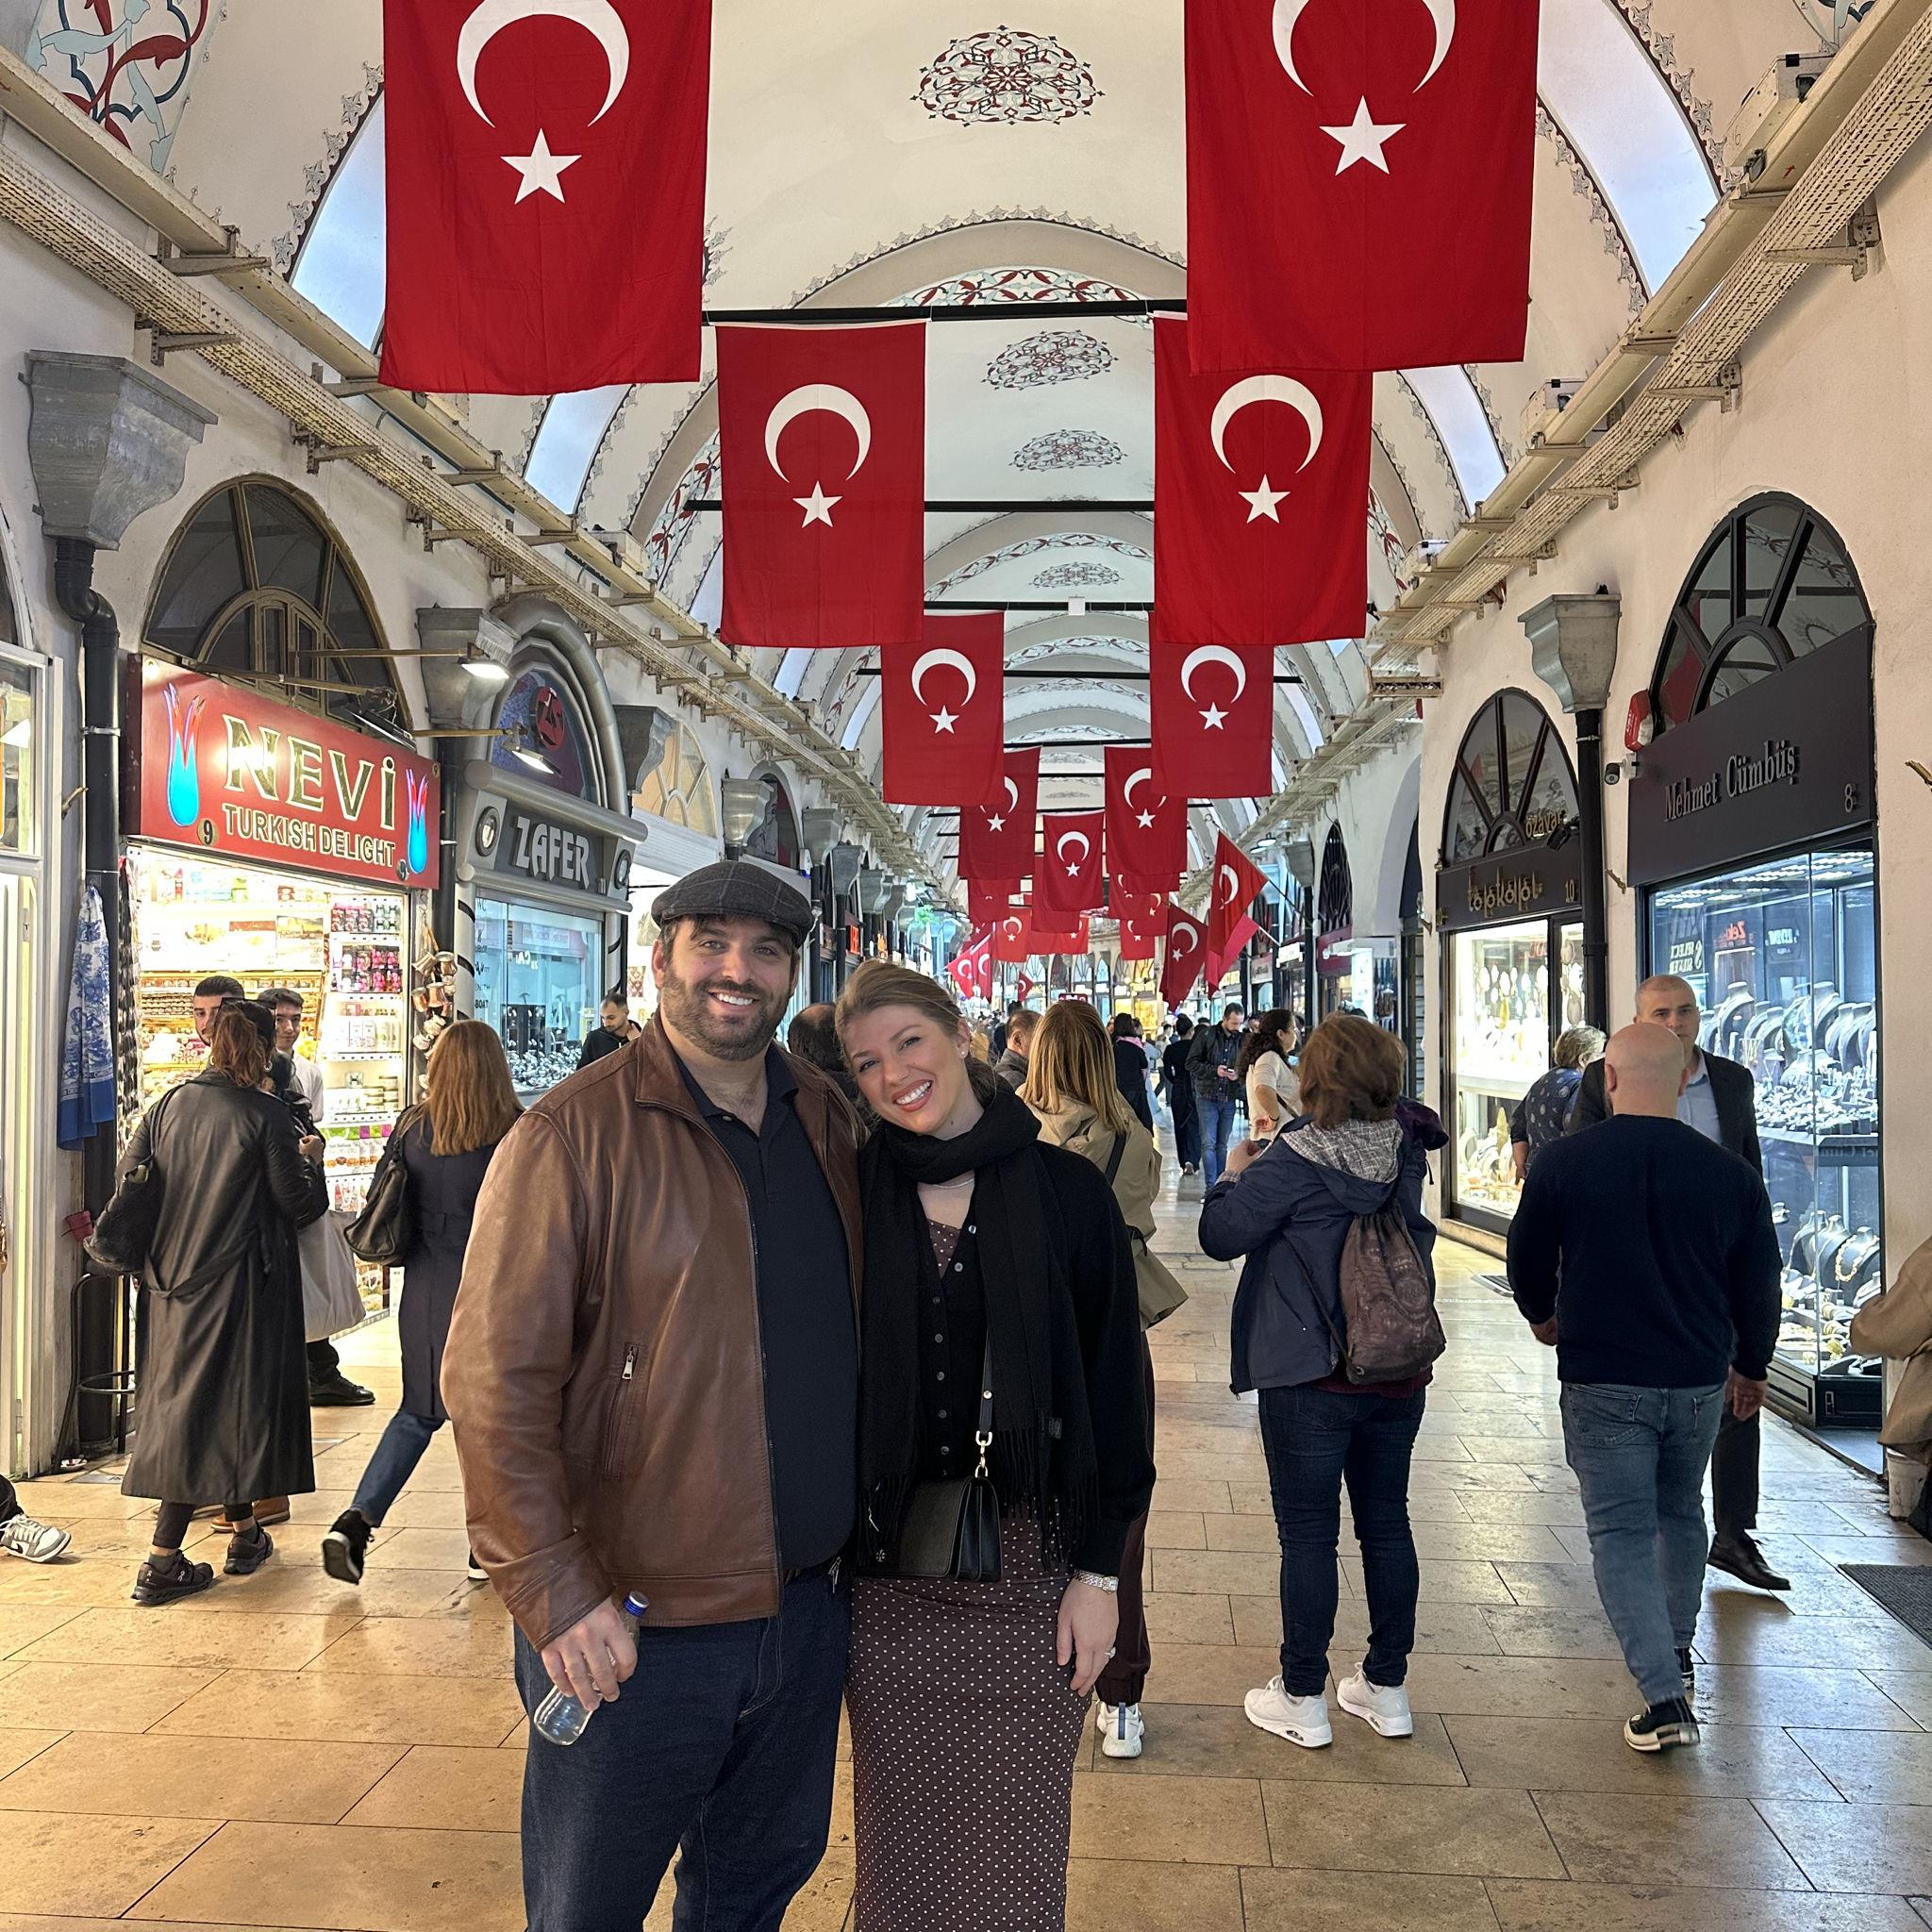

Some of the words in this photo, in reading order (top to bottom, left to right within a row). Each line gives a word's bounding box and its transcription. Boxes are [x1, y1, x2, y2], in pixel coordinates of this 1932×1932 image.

[1664, 773, 1718, 823] Mehmet
[1725, 739, 1796, 799] Cümbüş
[1844, 783, 1855, 814] 8
[202, 819, 213, 845] 9
[222, 803, 316, 853] TURKISH
[318, 825, 396, 868] DELIGHT
[515, 816, 591, 891] ZAFER
[1565, 878, 1575, 903] 10
